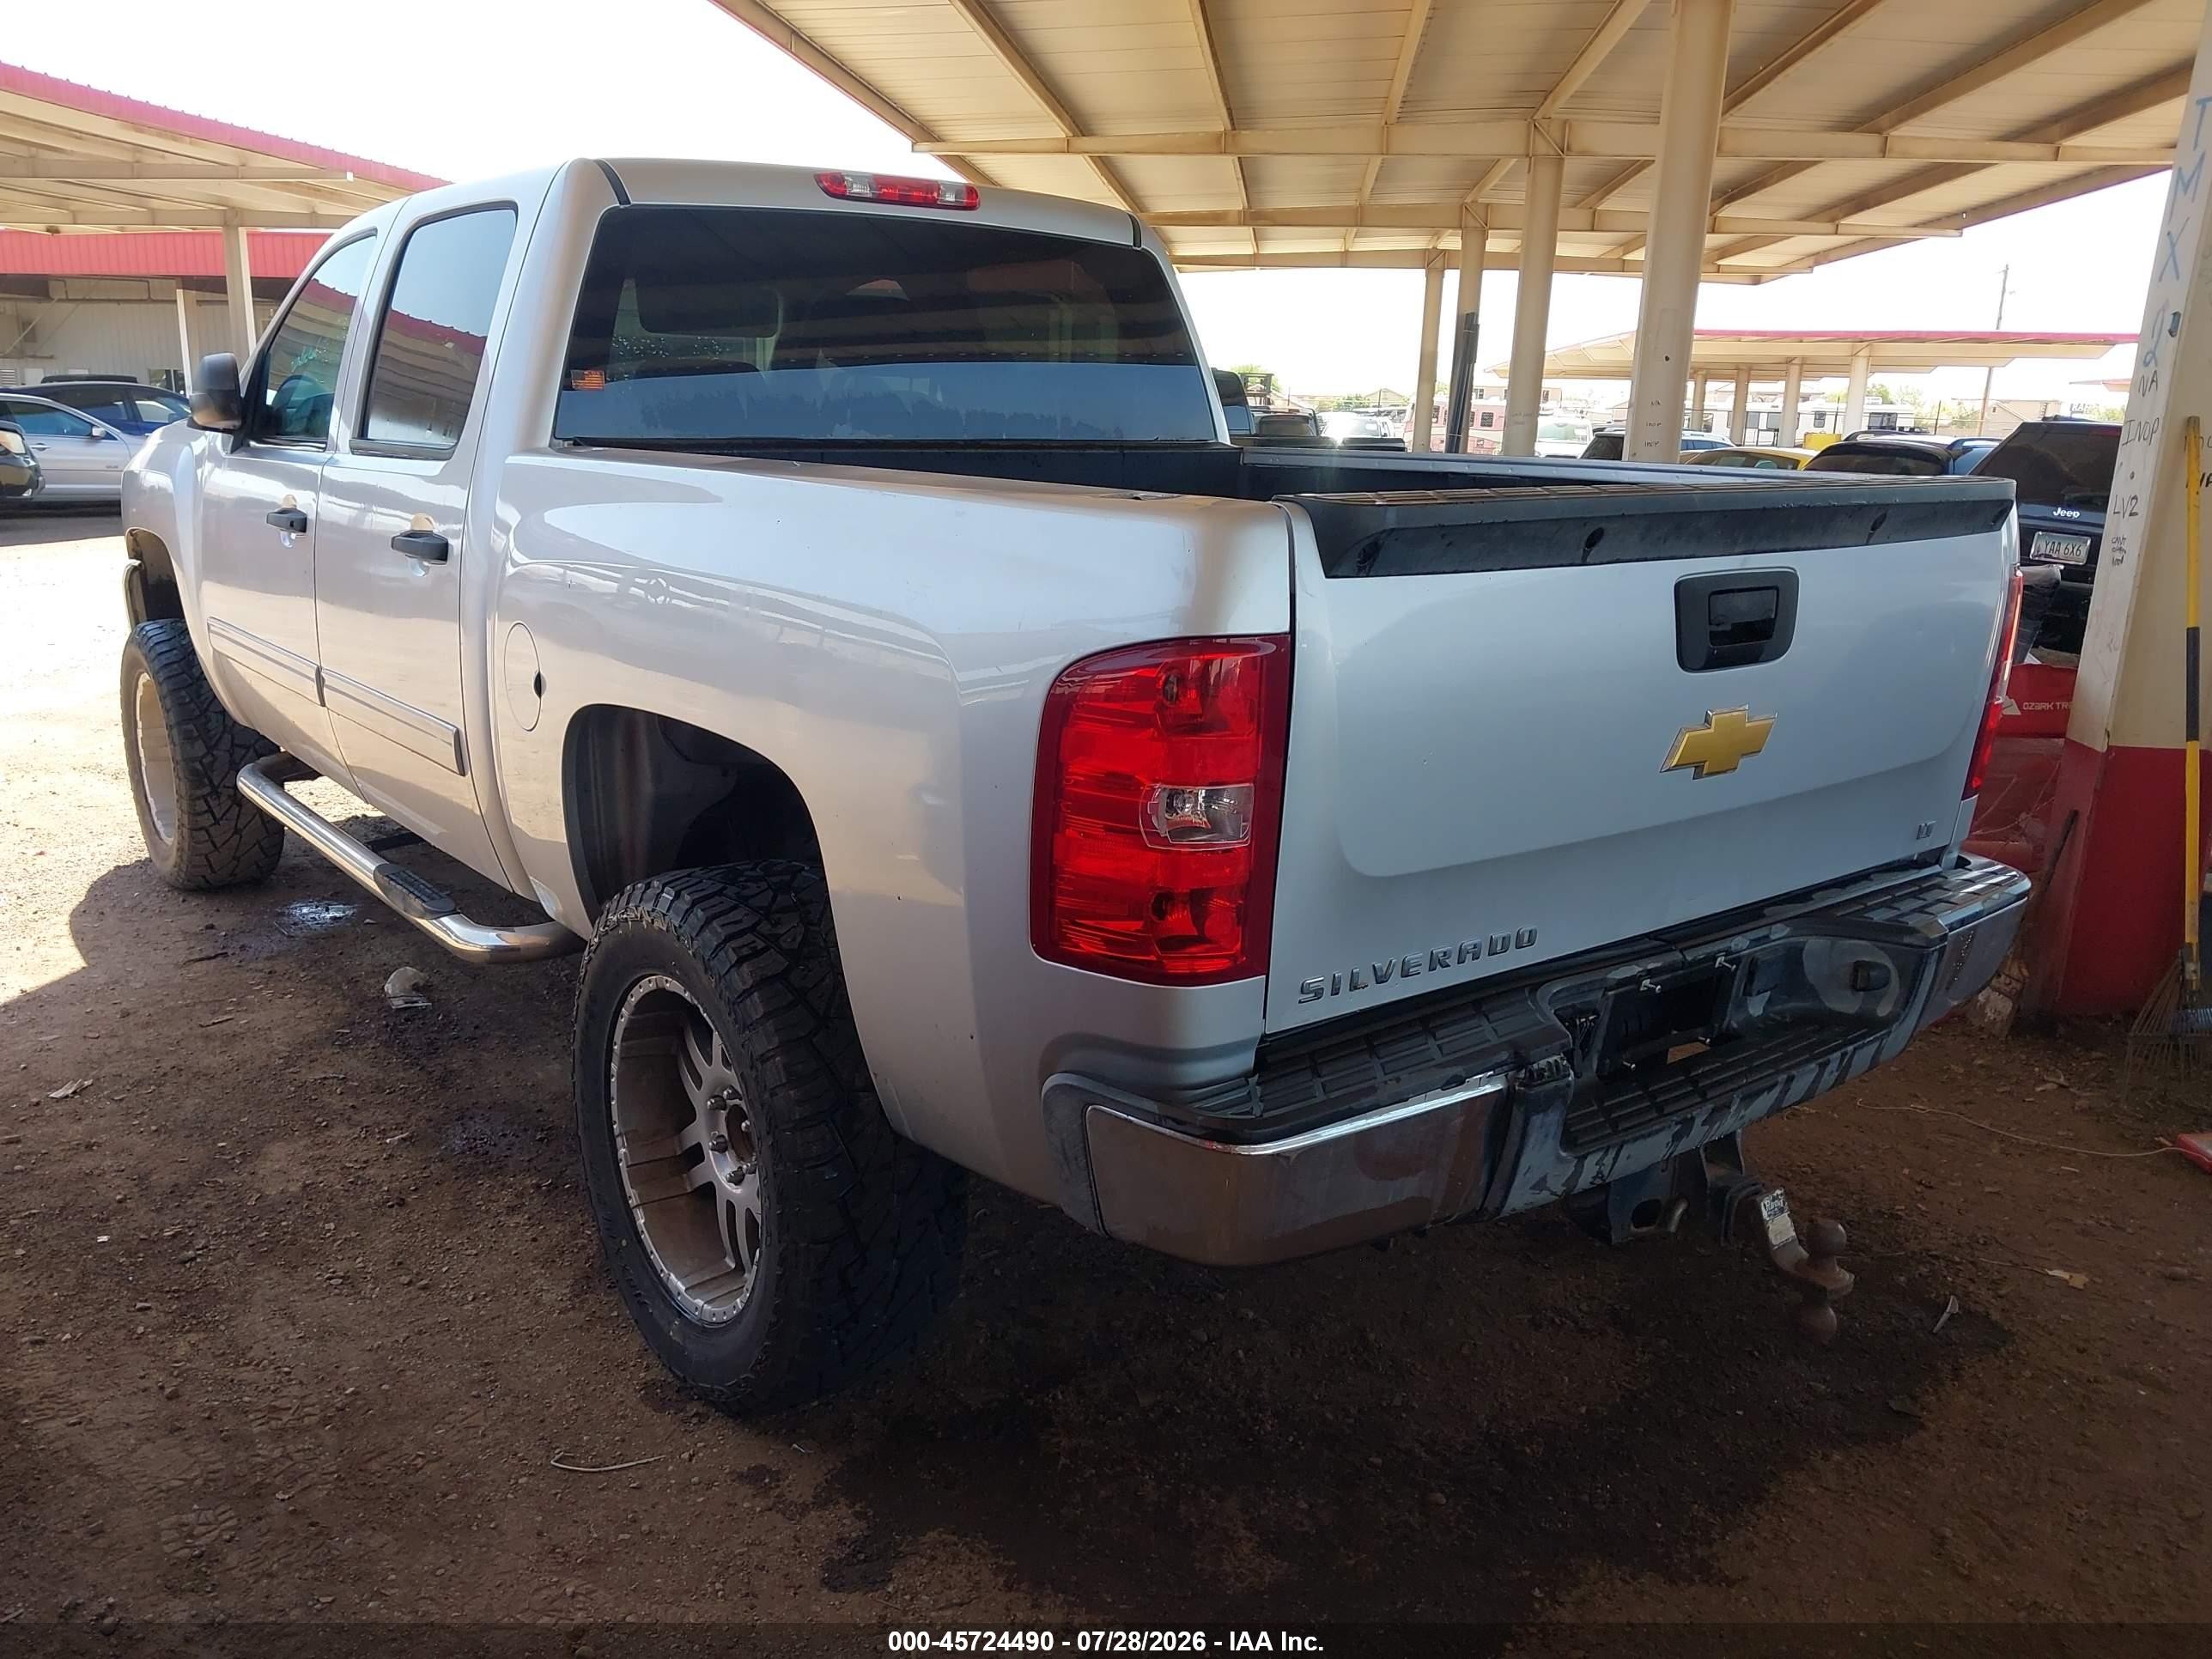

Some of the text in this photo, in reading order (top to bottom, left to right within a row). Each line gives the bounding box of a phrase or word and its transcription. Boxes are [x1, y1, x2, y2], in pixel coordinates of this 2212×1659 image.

[2138, 369, 2159, 398] NA
[2122, 417, 2160, 446] INOP
[2053, 507, 2081, 519] Jeep
[2113, 495, 2139, 519] LV2
[2063, 543, 2081, 557] 6X6
[2055, 702, 2069, 710] TR
[1298, 926, 1538, 1004] SILVERADO
